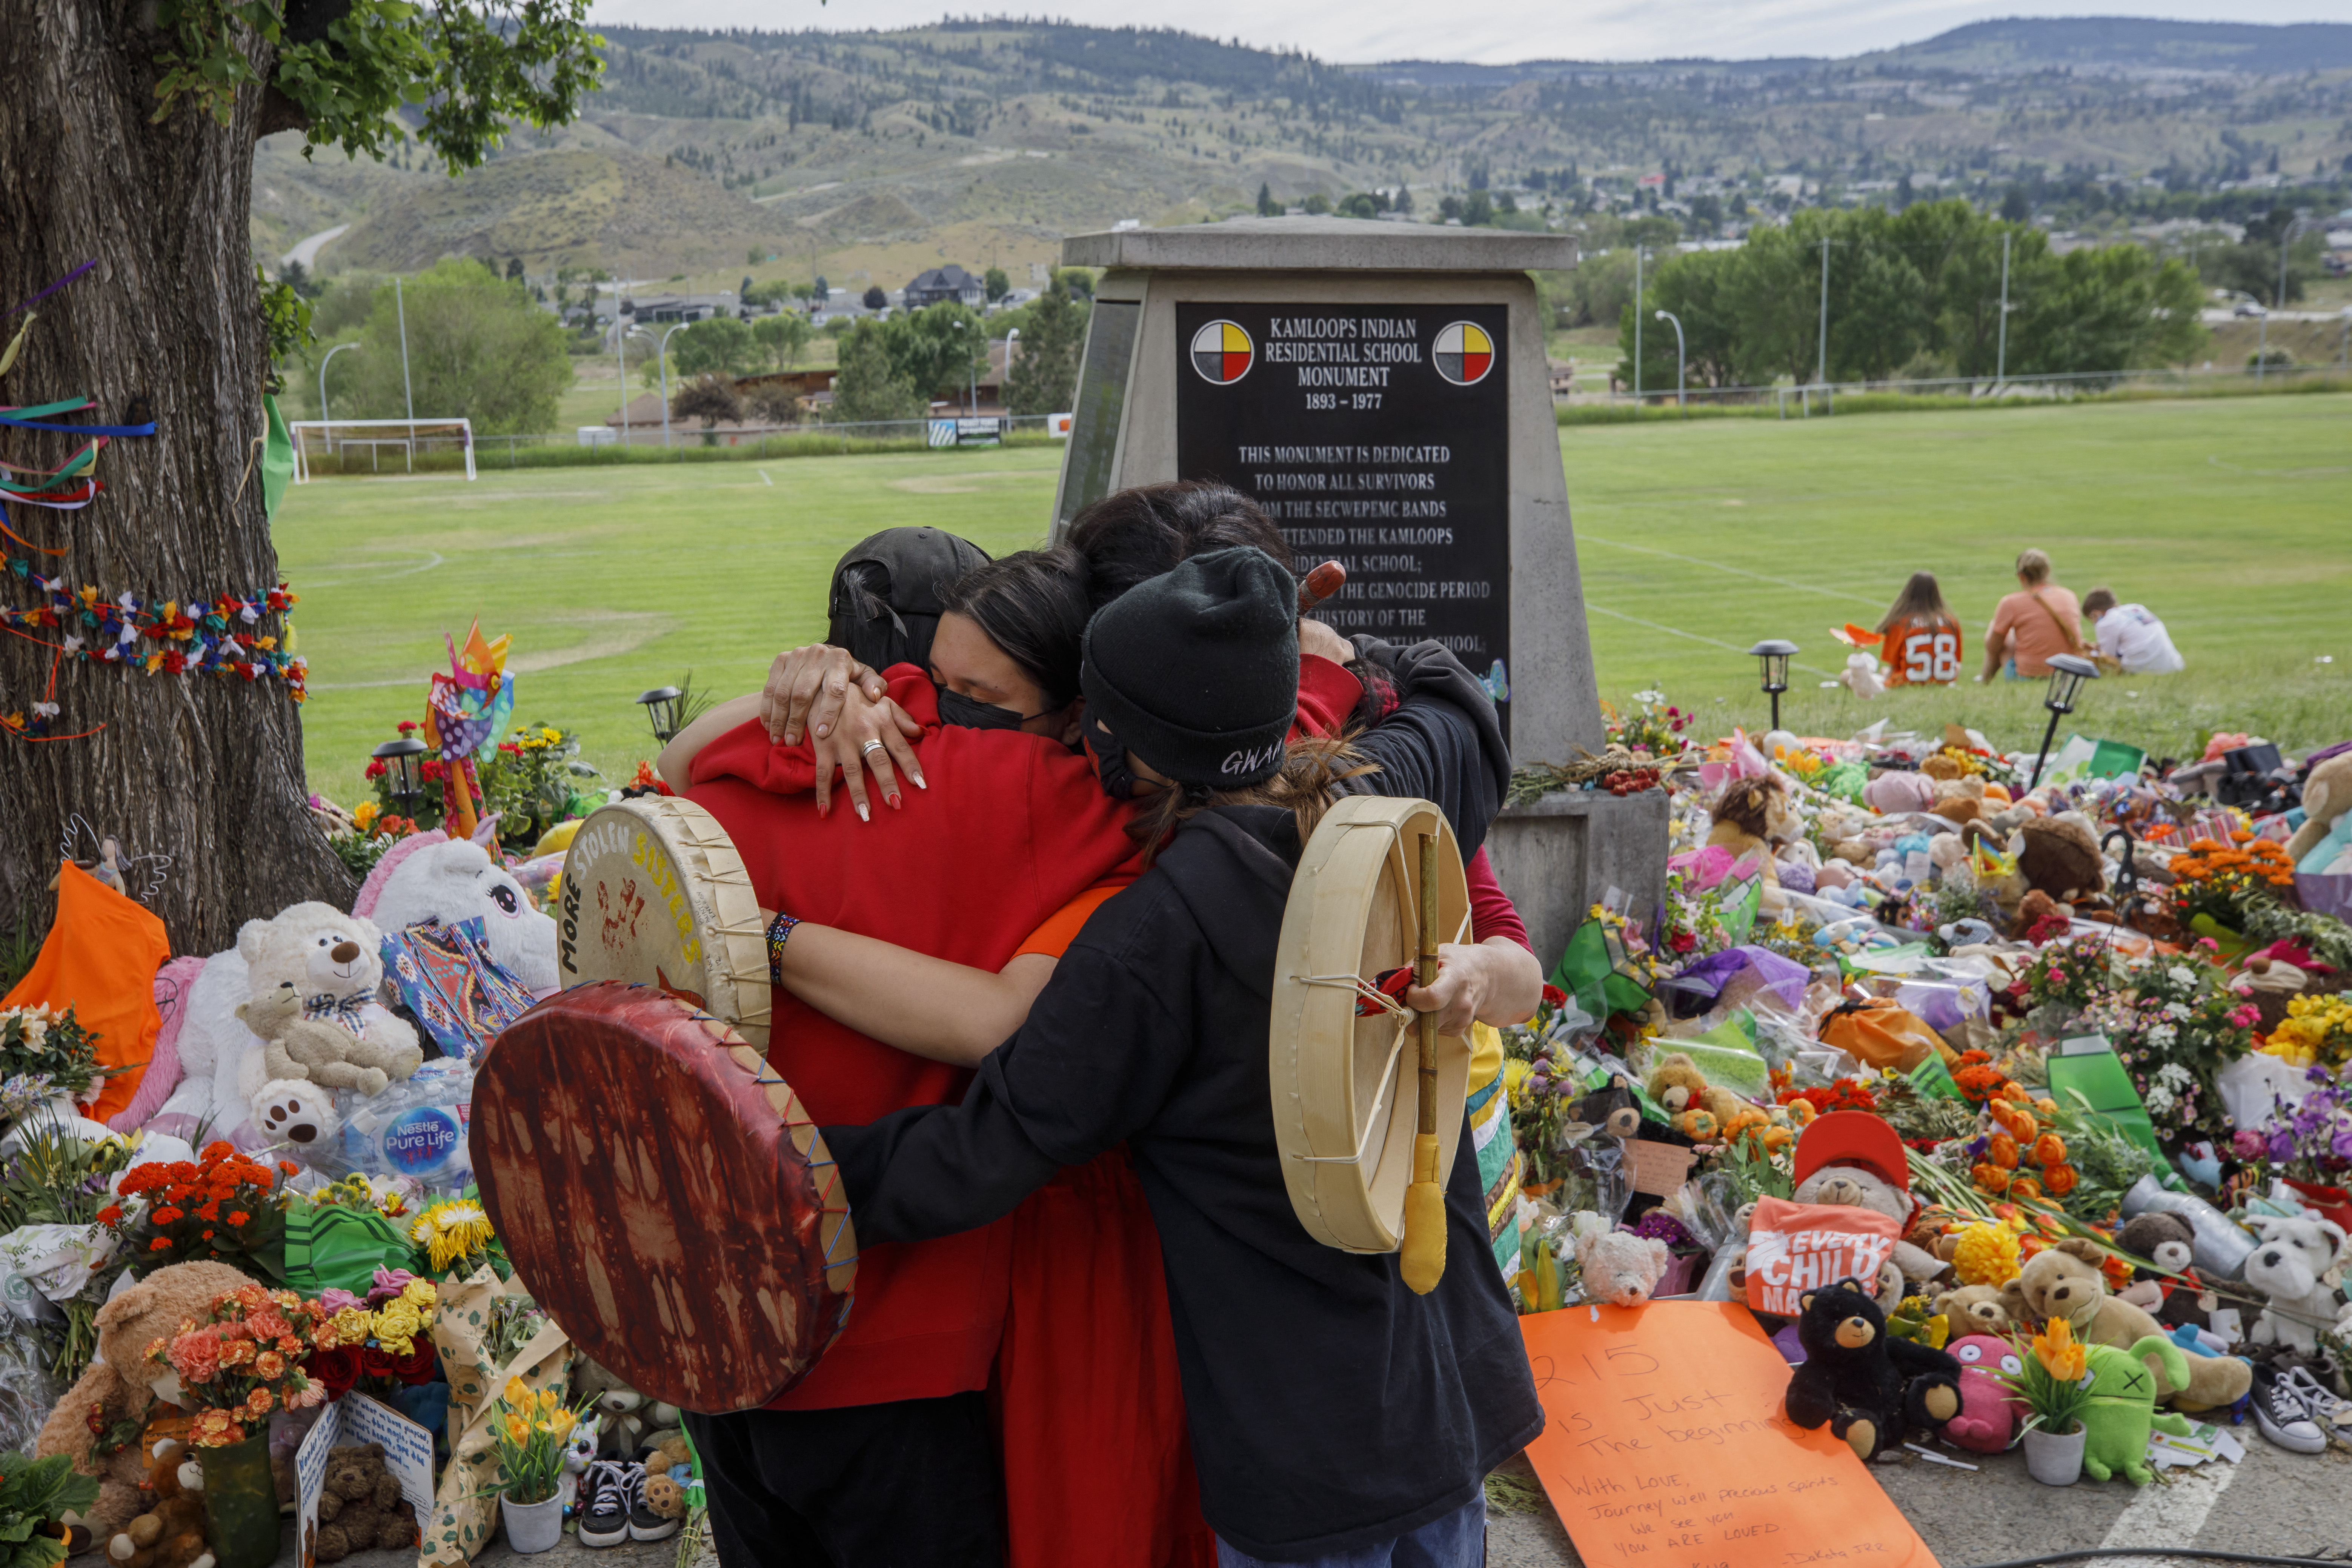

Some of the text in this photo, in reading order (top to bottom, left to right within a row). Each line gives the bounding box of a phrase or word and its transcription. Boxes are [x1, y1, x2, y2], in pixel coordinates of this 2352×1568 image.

[1271, 318, 1416, 339] KAMLOOPS INDIAN
[1265, 343, 1422, 363] RESIDENTIAL SCHOOL
[1298, 367, 1390, 387] MONUMENT
[1306, 394, 1336, 410] 1893
[1351, 394, 1382, 410] 1977
[1239, 446, 1450, 463] THIS MONUMENT IS DEDICATED
[1255, 473, 1435, 490] TO HONOR ALL SURVIVORS
[1284, 501, 1313, 518] THE
[1315, 500, 1399, 518] SECWEPEMC
[1402, 501, 1447, 518] BANDS
[1348, 528, 1376, 545] THE
[1379, 528, 1453, 545] KAMLOOPS
[1339, 581, 1491, 599] THE GENOCIDE PERIOD
[1316, 609, 1426, 627] HISTORY OF THE
[1905, 633, 1957, 681] 58
[561, 821, 702, 975] MORE STOLEN SISTERS
[696, 892, 716, 919] ENERGY
[695, 899, 711, 923] AUNTIE
[386, 1130, 454, 1150] Pure Life
[1792, 1230, 1891, 1253] EVERY
[1761, 1247, 1881, 1289] CHILD
[1532, 1344, 1659, 1391] 215
[1657, 1416, 1807, 1445] beginning
[1560, 1474, 1626, 1497] With
[1667, 1534, 1705, 1548] ARE
